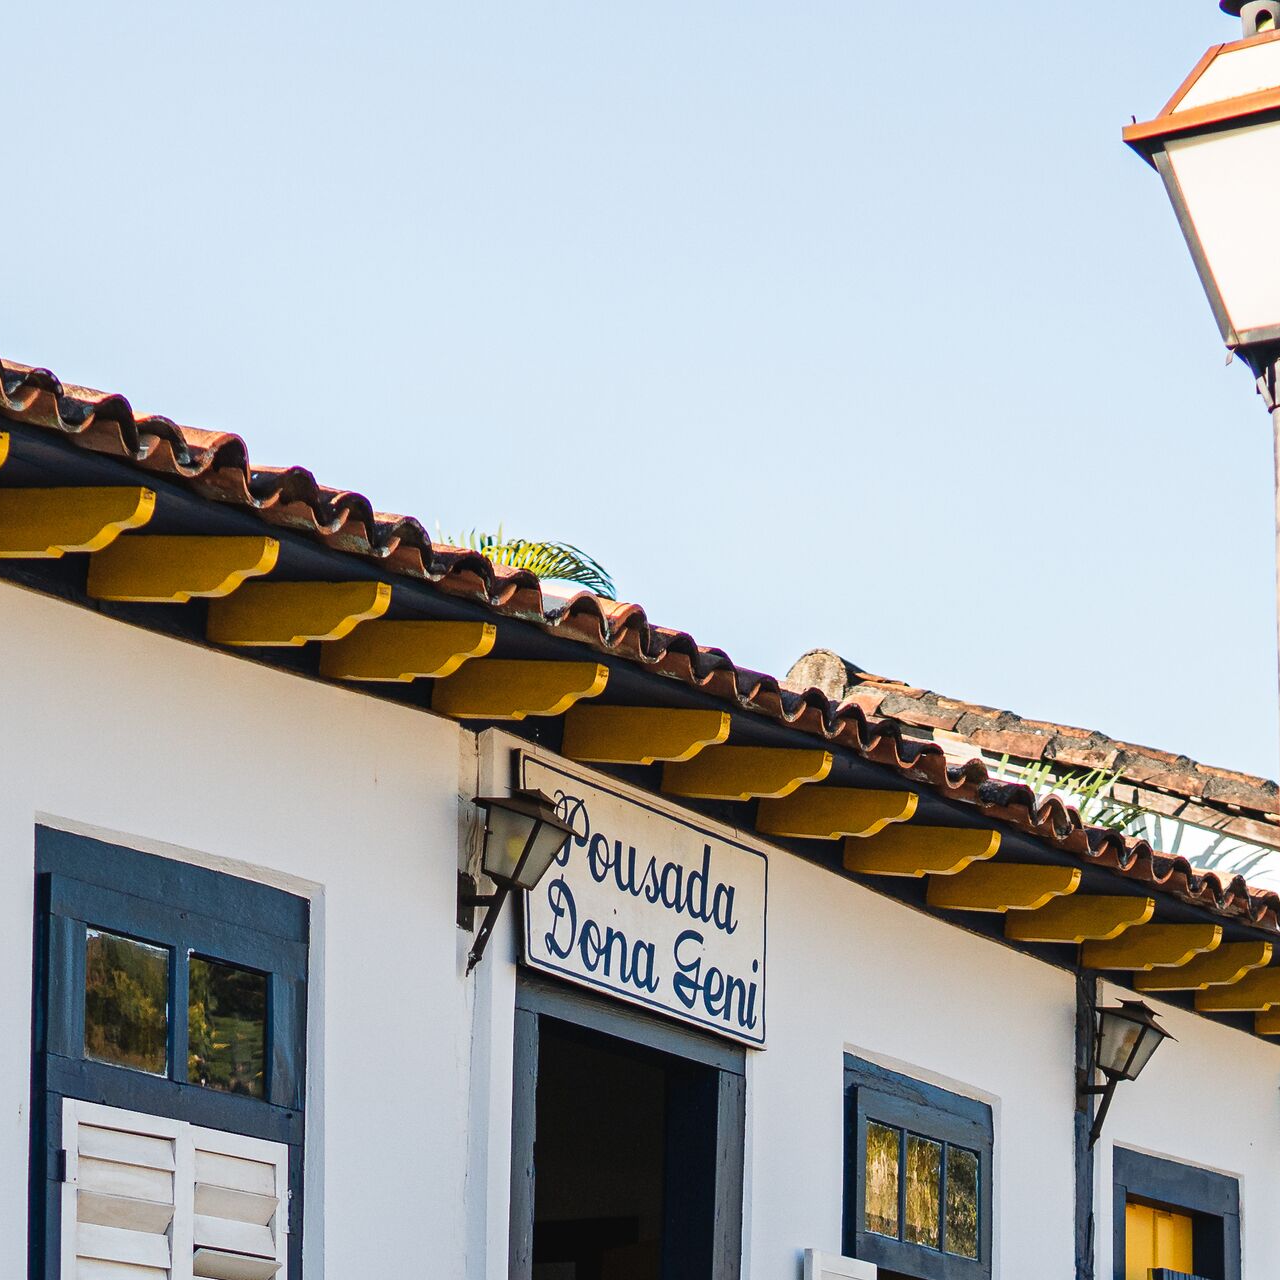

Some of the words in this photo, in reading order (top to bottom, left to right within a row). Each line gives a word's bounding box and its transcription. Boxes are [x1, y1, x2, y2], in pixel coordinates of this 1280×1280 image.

[553, 789, 738, 935] Pousada
[545, 873, 660, 993] Dona
[672, 929, 758, 1030] Geni
